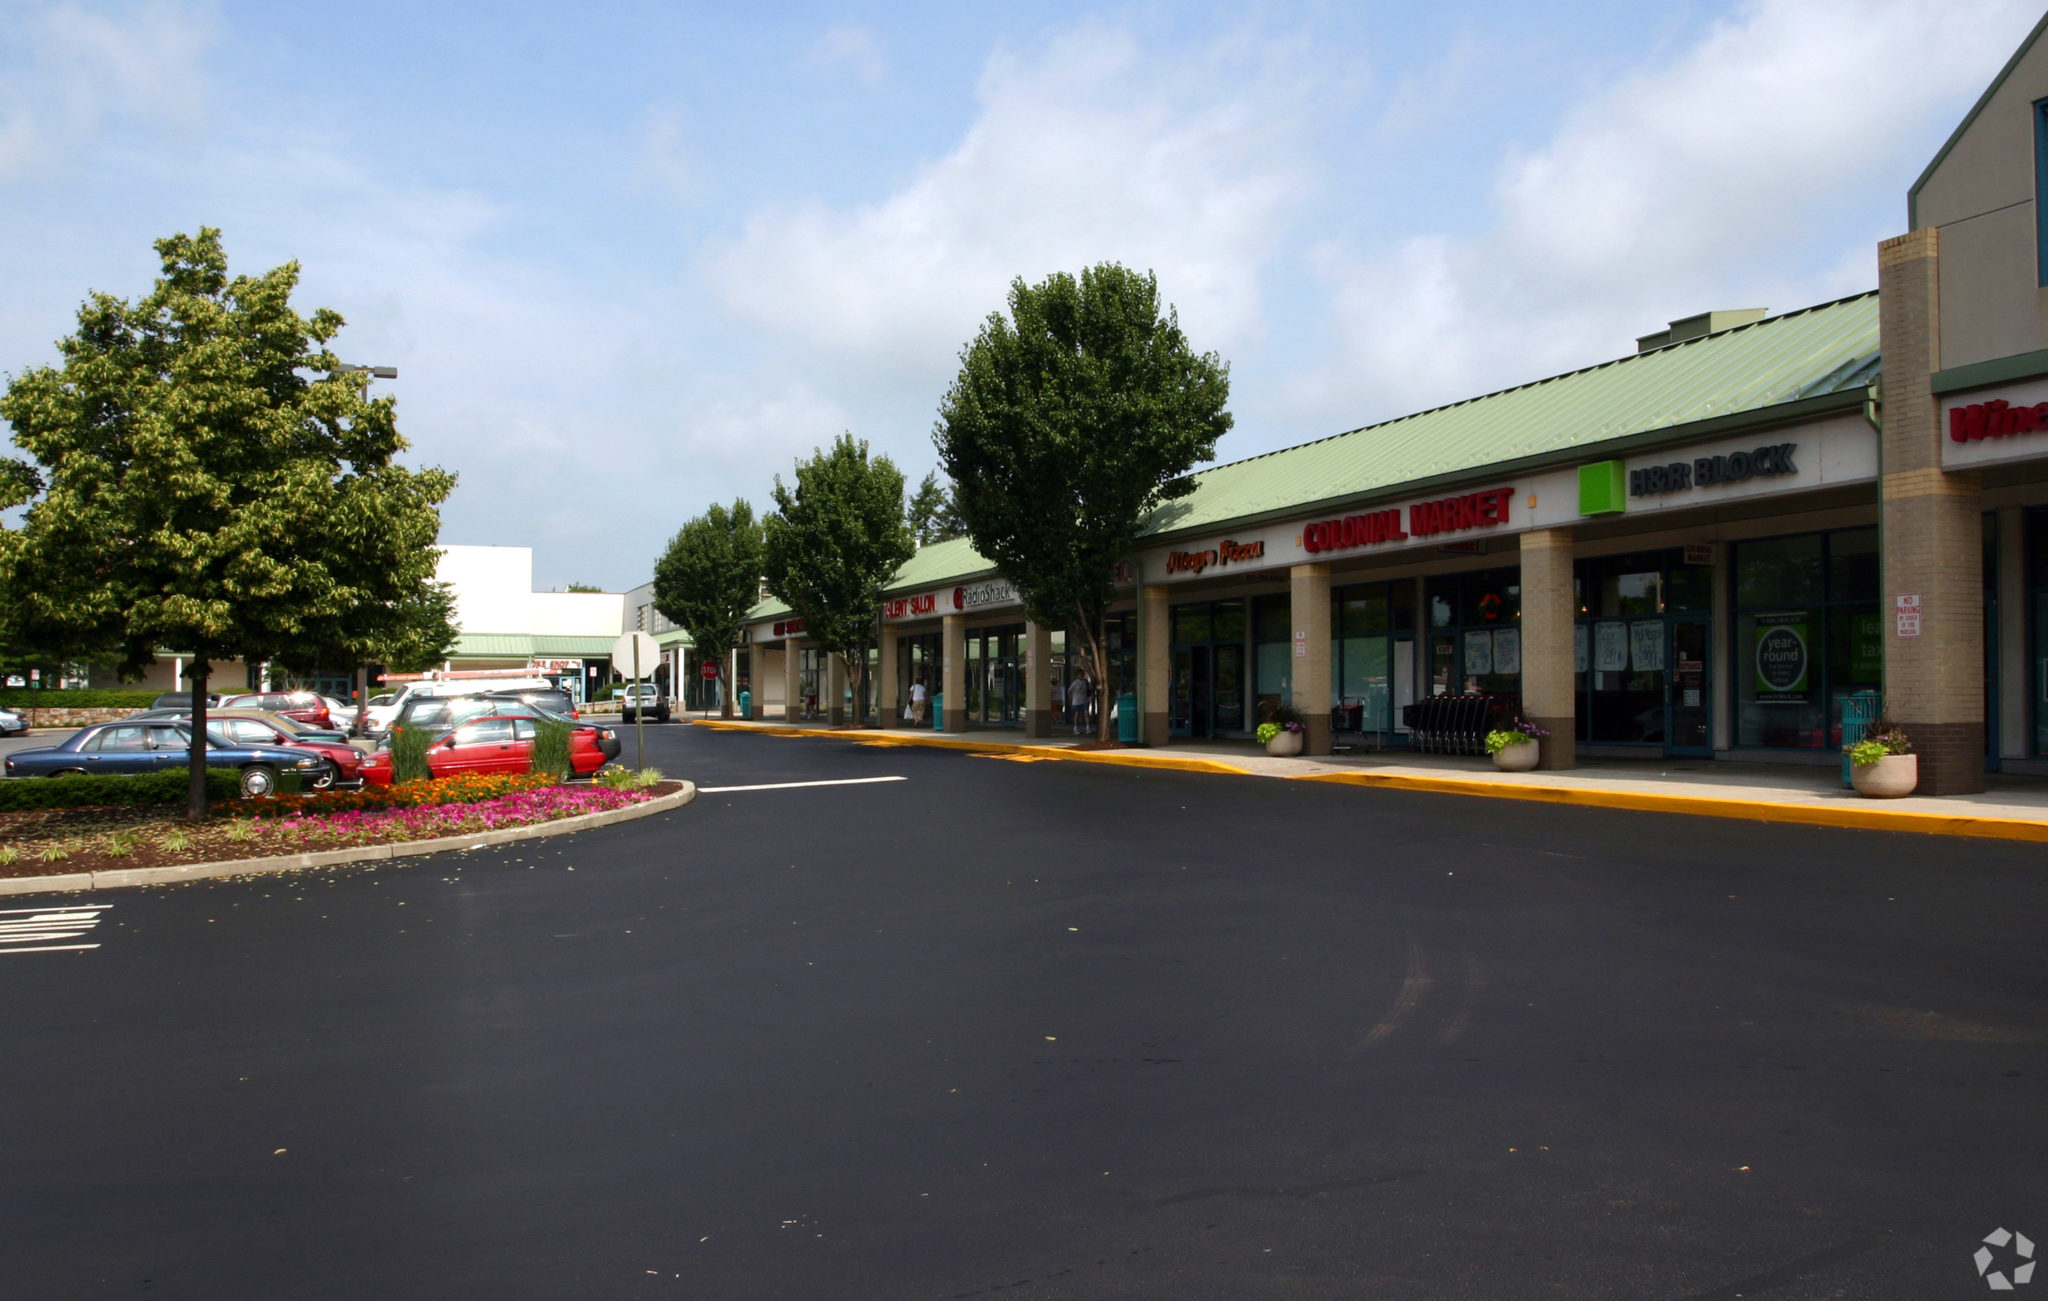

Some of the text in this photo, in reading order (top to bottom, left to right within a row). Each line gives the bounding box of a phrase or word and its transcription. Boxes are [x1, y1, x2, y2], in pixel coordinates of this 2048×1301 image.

[1630, 443, 1797, 496] H&R BLOCK
[1303, 488, 1514, 552] COLONIAL MARKET
[1166, 540, 1264, 574] Allegro Pizza
[962, 582, 1010, 606] RadioShack
[1903, 597, 1913, 605] NO
[911, 594, 936, 615] SALON
[1896, 605, 1920, 614] PARKING
[1768, 638, 1797, 652] year-
[1763, 648, 1798, 662] round
[703, 666, 717, 674] STOP
